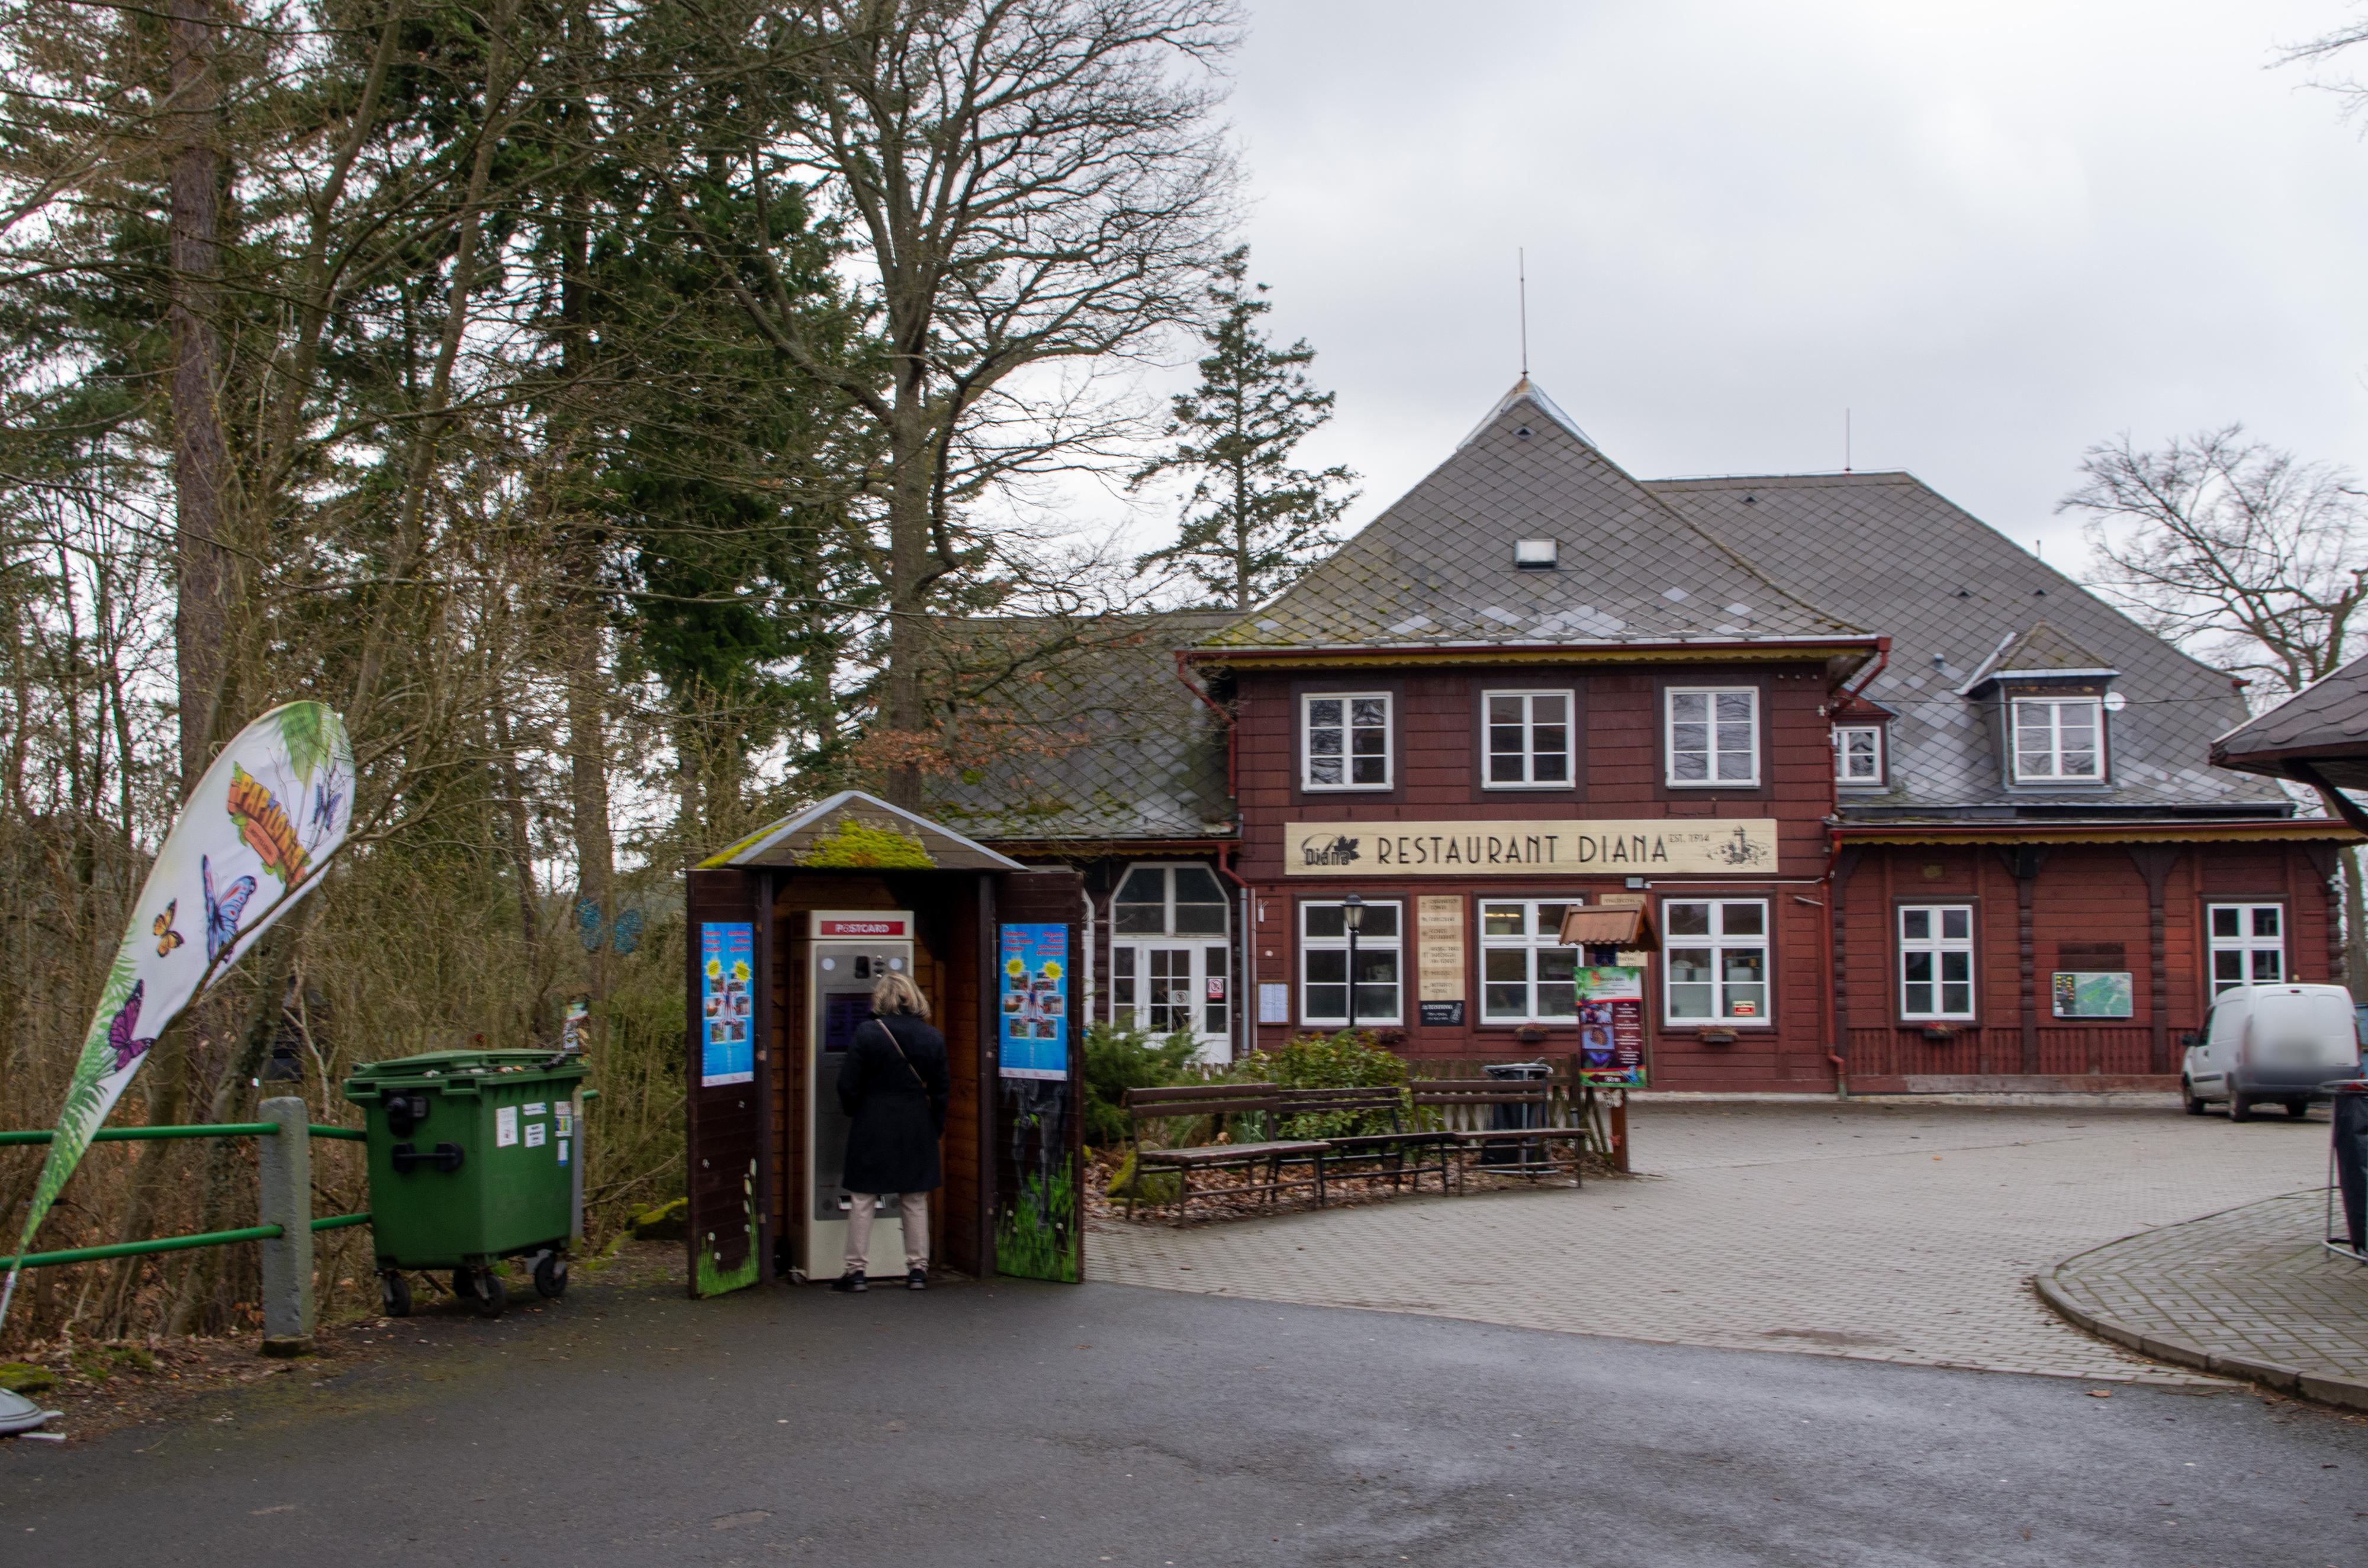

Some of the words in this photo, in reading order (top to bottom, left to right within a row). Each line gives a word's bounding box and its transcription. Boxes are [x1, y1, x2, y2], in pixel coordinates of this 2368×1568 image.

[1305, 848, 1350, 865] Diana
[1378, 835, 1559, 864] RESTAURANT
[1579, 834, 1668, 863] DIANA
[835, 924, 890, 933] POSTCARD
